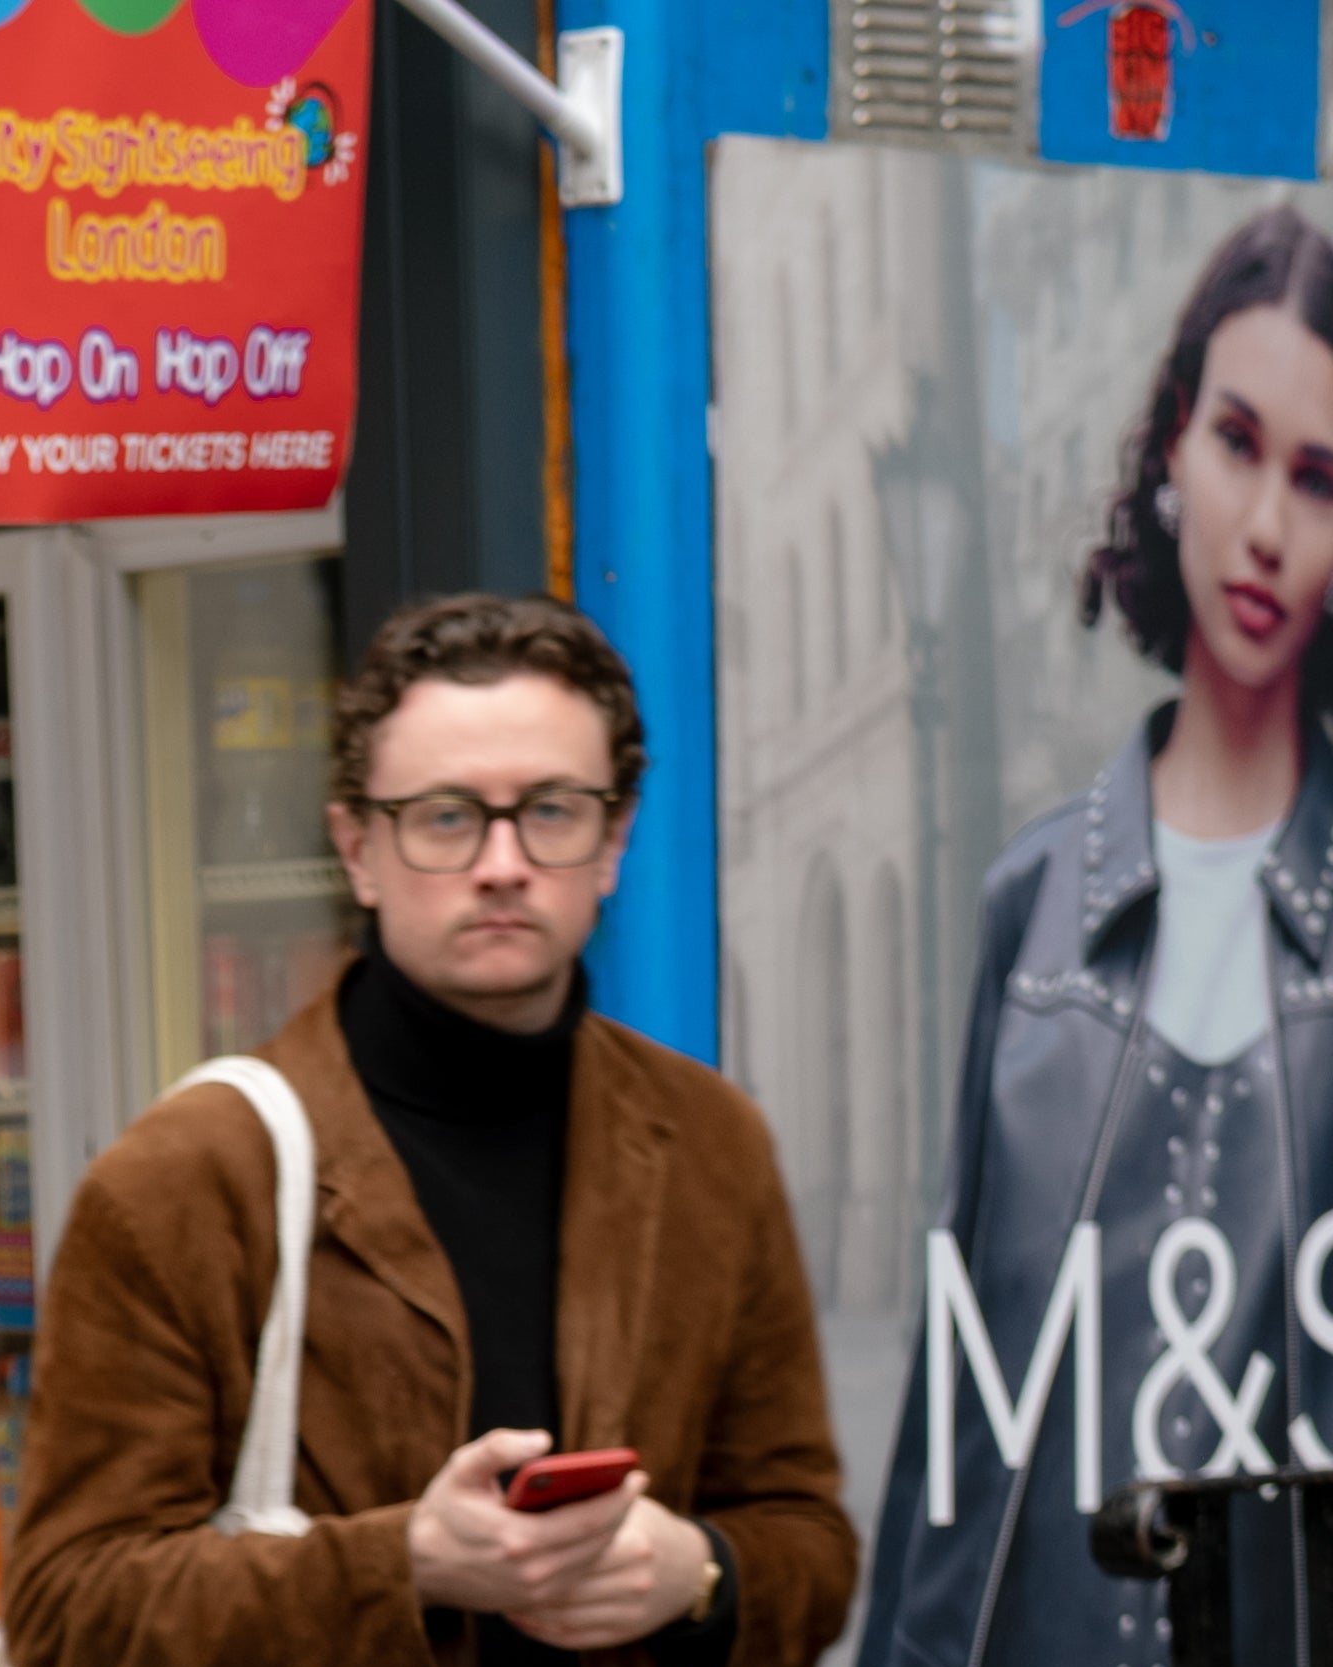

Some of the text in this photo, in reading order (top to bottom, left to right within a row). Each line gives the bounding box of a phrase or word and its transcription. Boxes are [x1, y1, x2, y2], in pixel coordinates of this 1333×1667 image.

[51, 109, 307, 202] Sightseeing
[46, 196, 228, 285] London
[77, 325, 141, 404] On
[154, 326, 240, 408] Hop
[242, 324, 313, 402] Off
[21, 434, 118, 475] YOUR
[121, 432, 247, 473] TICKETS
[248, 430, 335, 471] HERE
